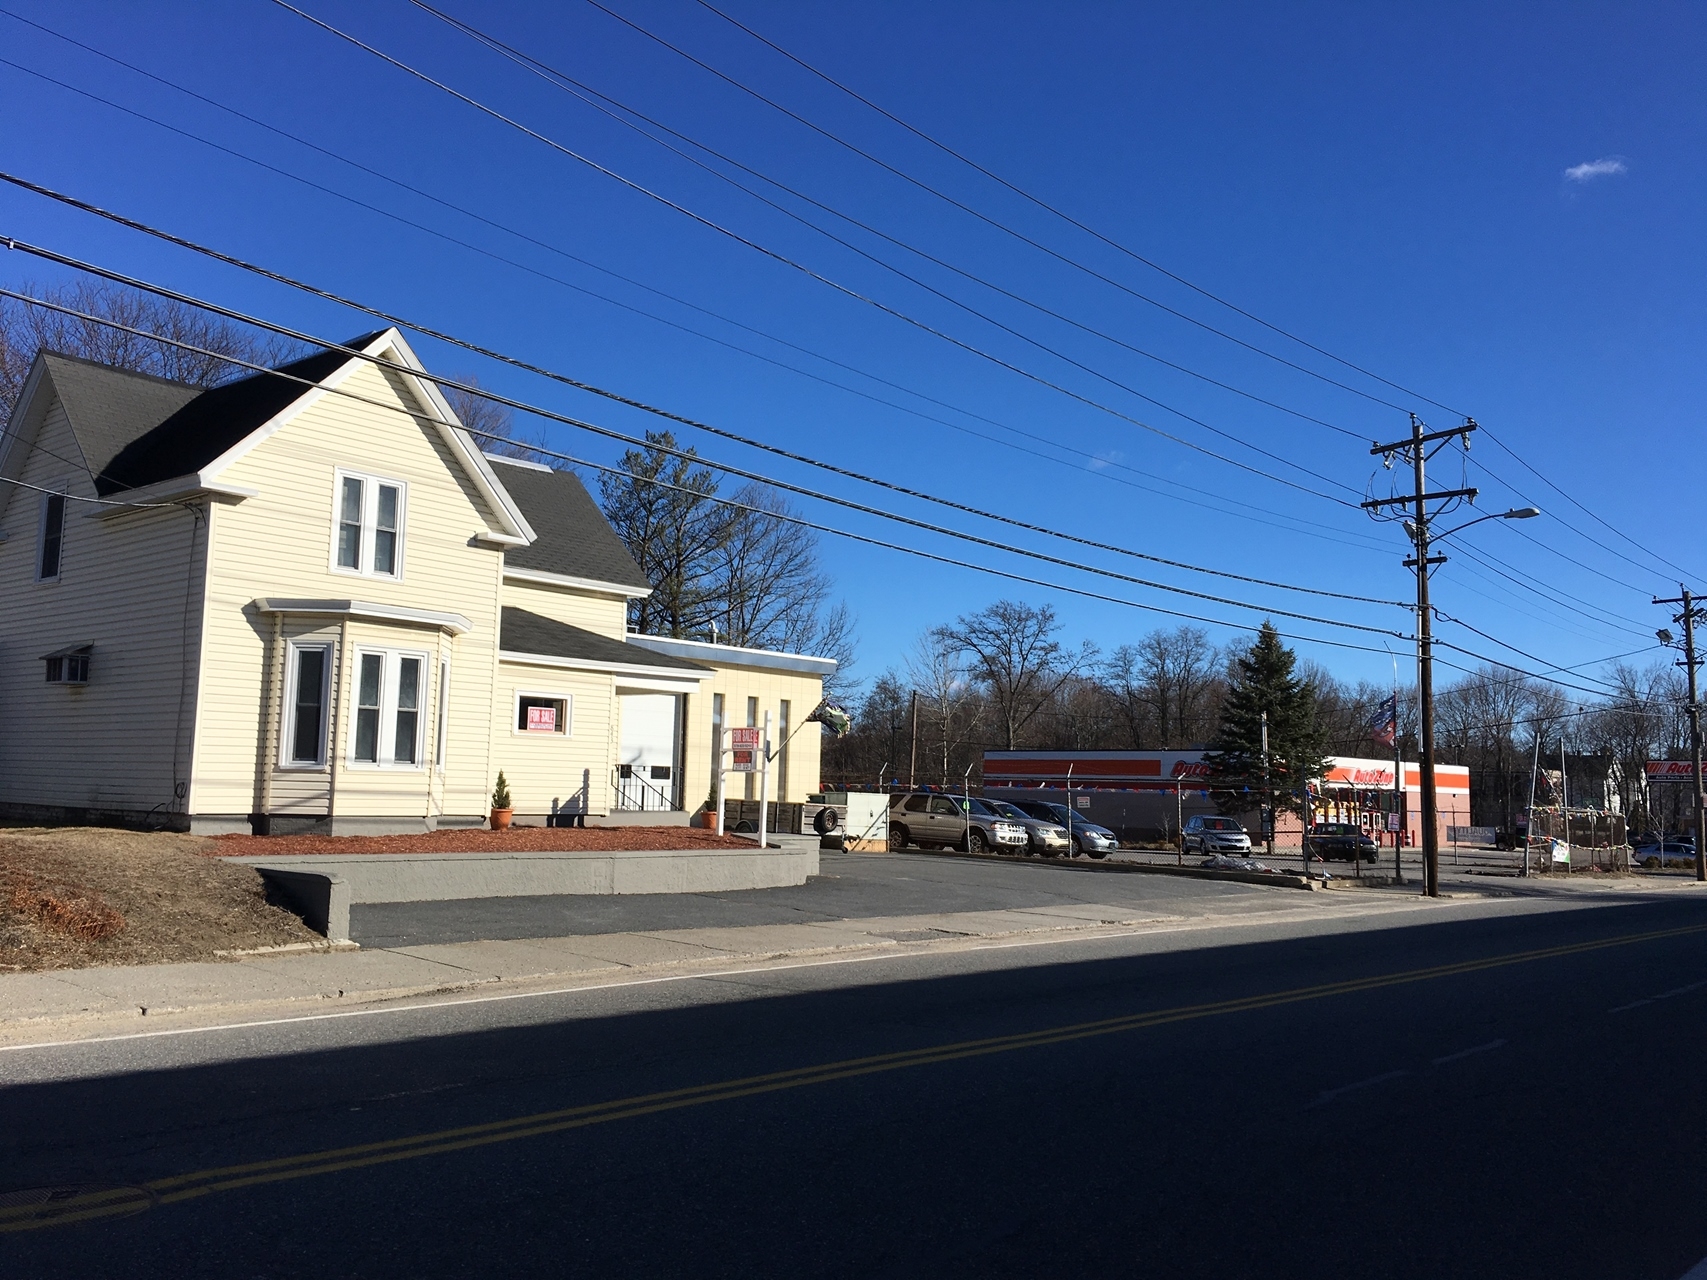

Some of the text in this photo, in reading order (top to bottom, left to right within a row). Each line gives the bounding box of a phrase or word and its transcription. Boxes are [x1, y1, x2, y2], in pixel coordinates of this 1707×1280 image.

[530, 710, 554, 723] FOR SALE
[733, 730, 742, 742] FOR
[742, 730, 753, 742] SALE
[1353, 768, 1394, 785] AutoZone
